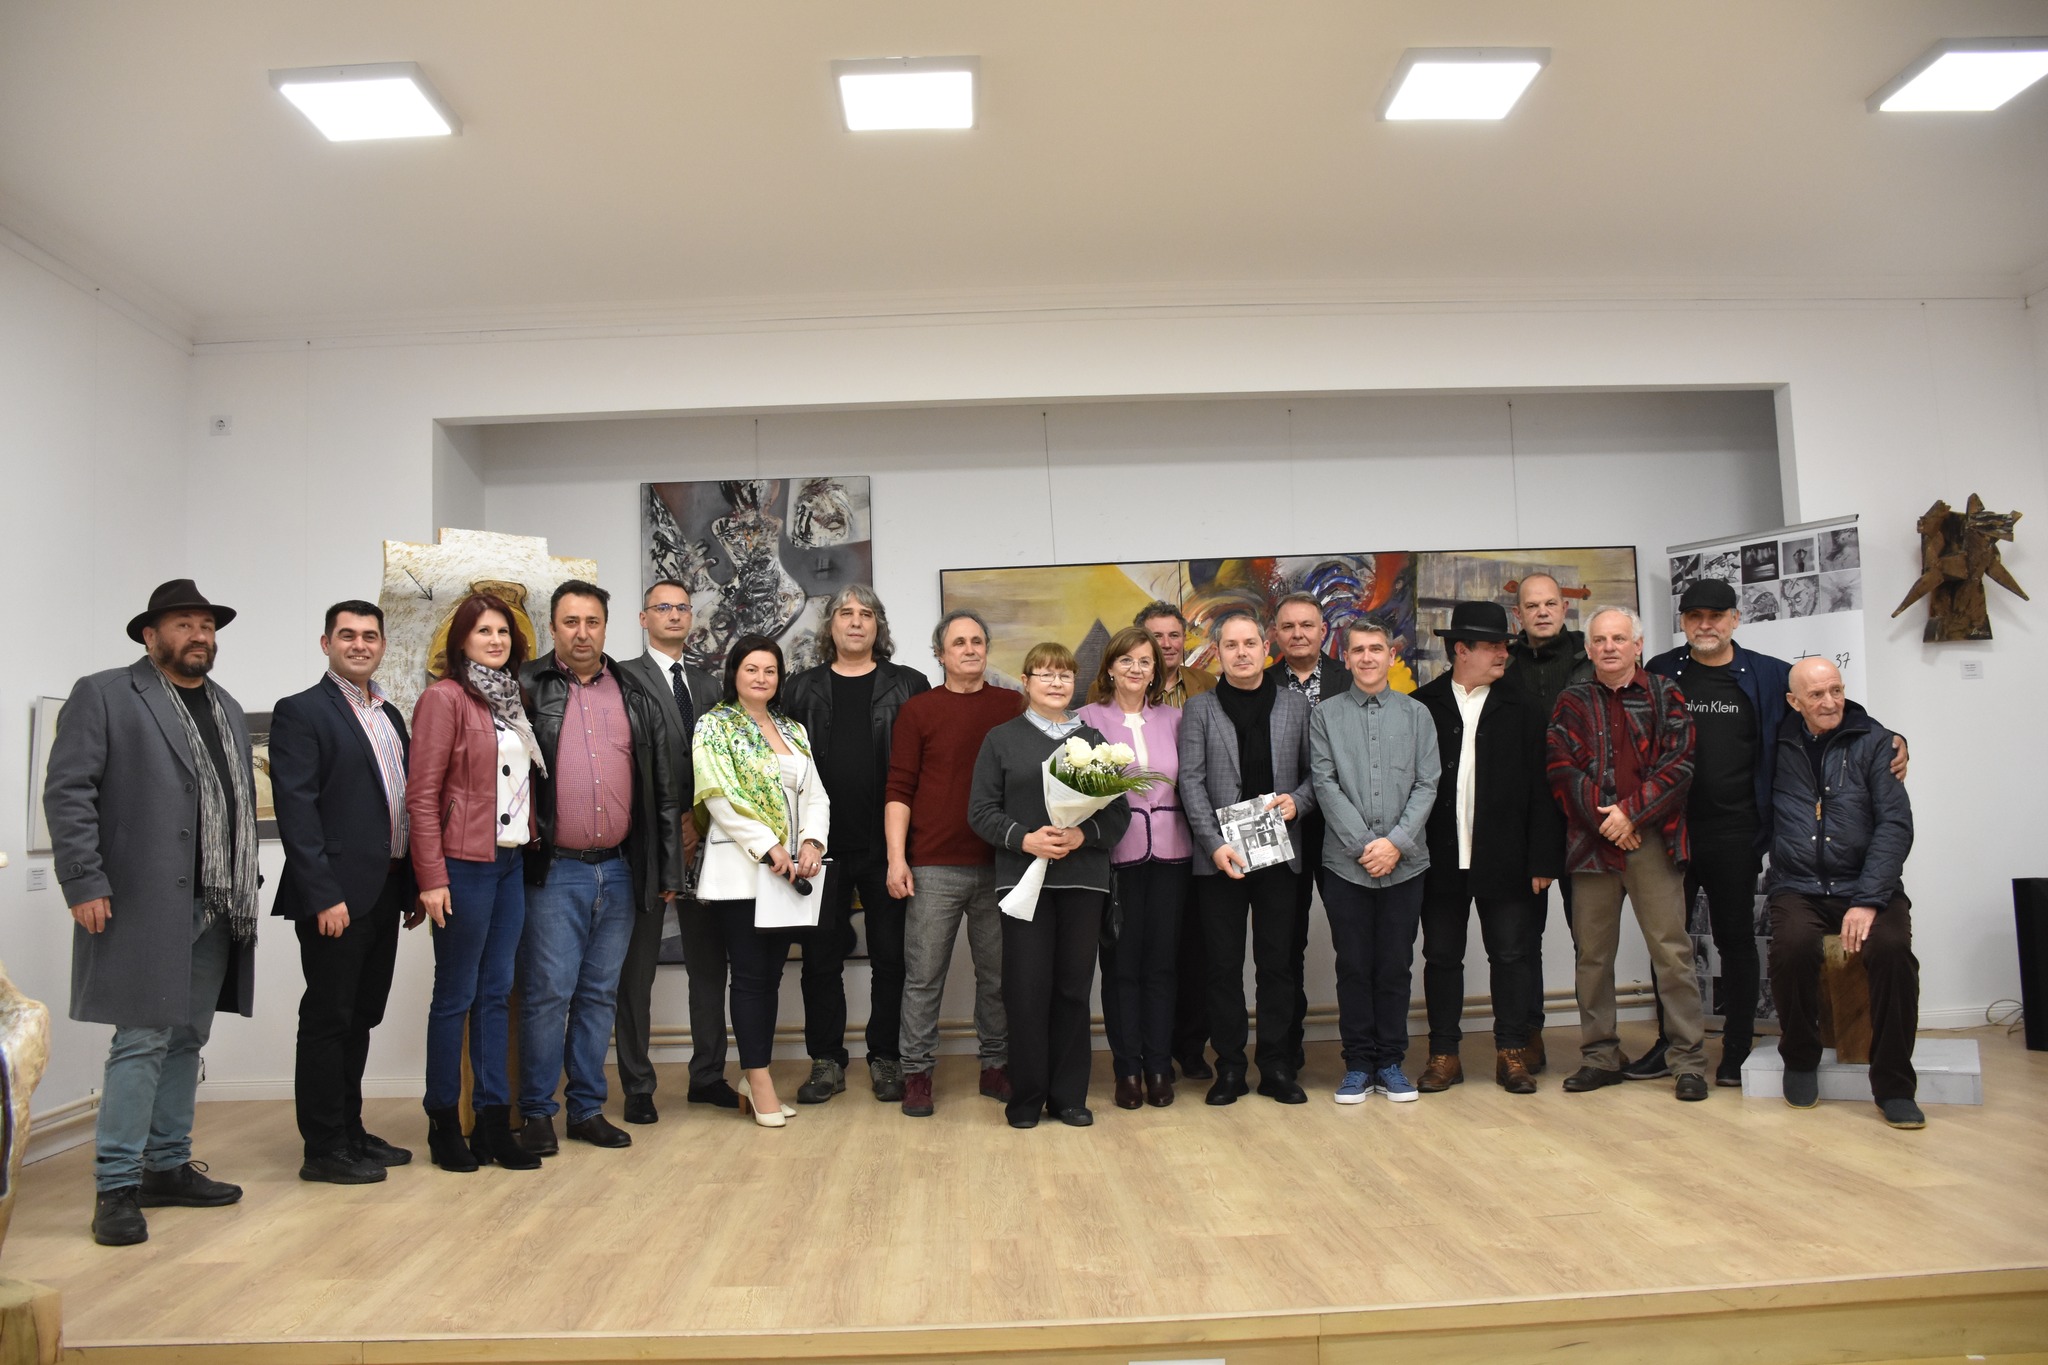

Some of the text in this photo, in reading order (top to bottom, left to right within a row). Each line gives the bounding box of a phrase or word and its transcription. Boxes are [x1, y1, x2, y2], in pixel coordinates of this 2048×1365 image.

[1835, 651, 1851, 669] 37
[1684, 699, 1739, 714] alvin Klein
